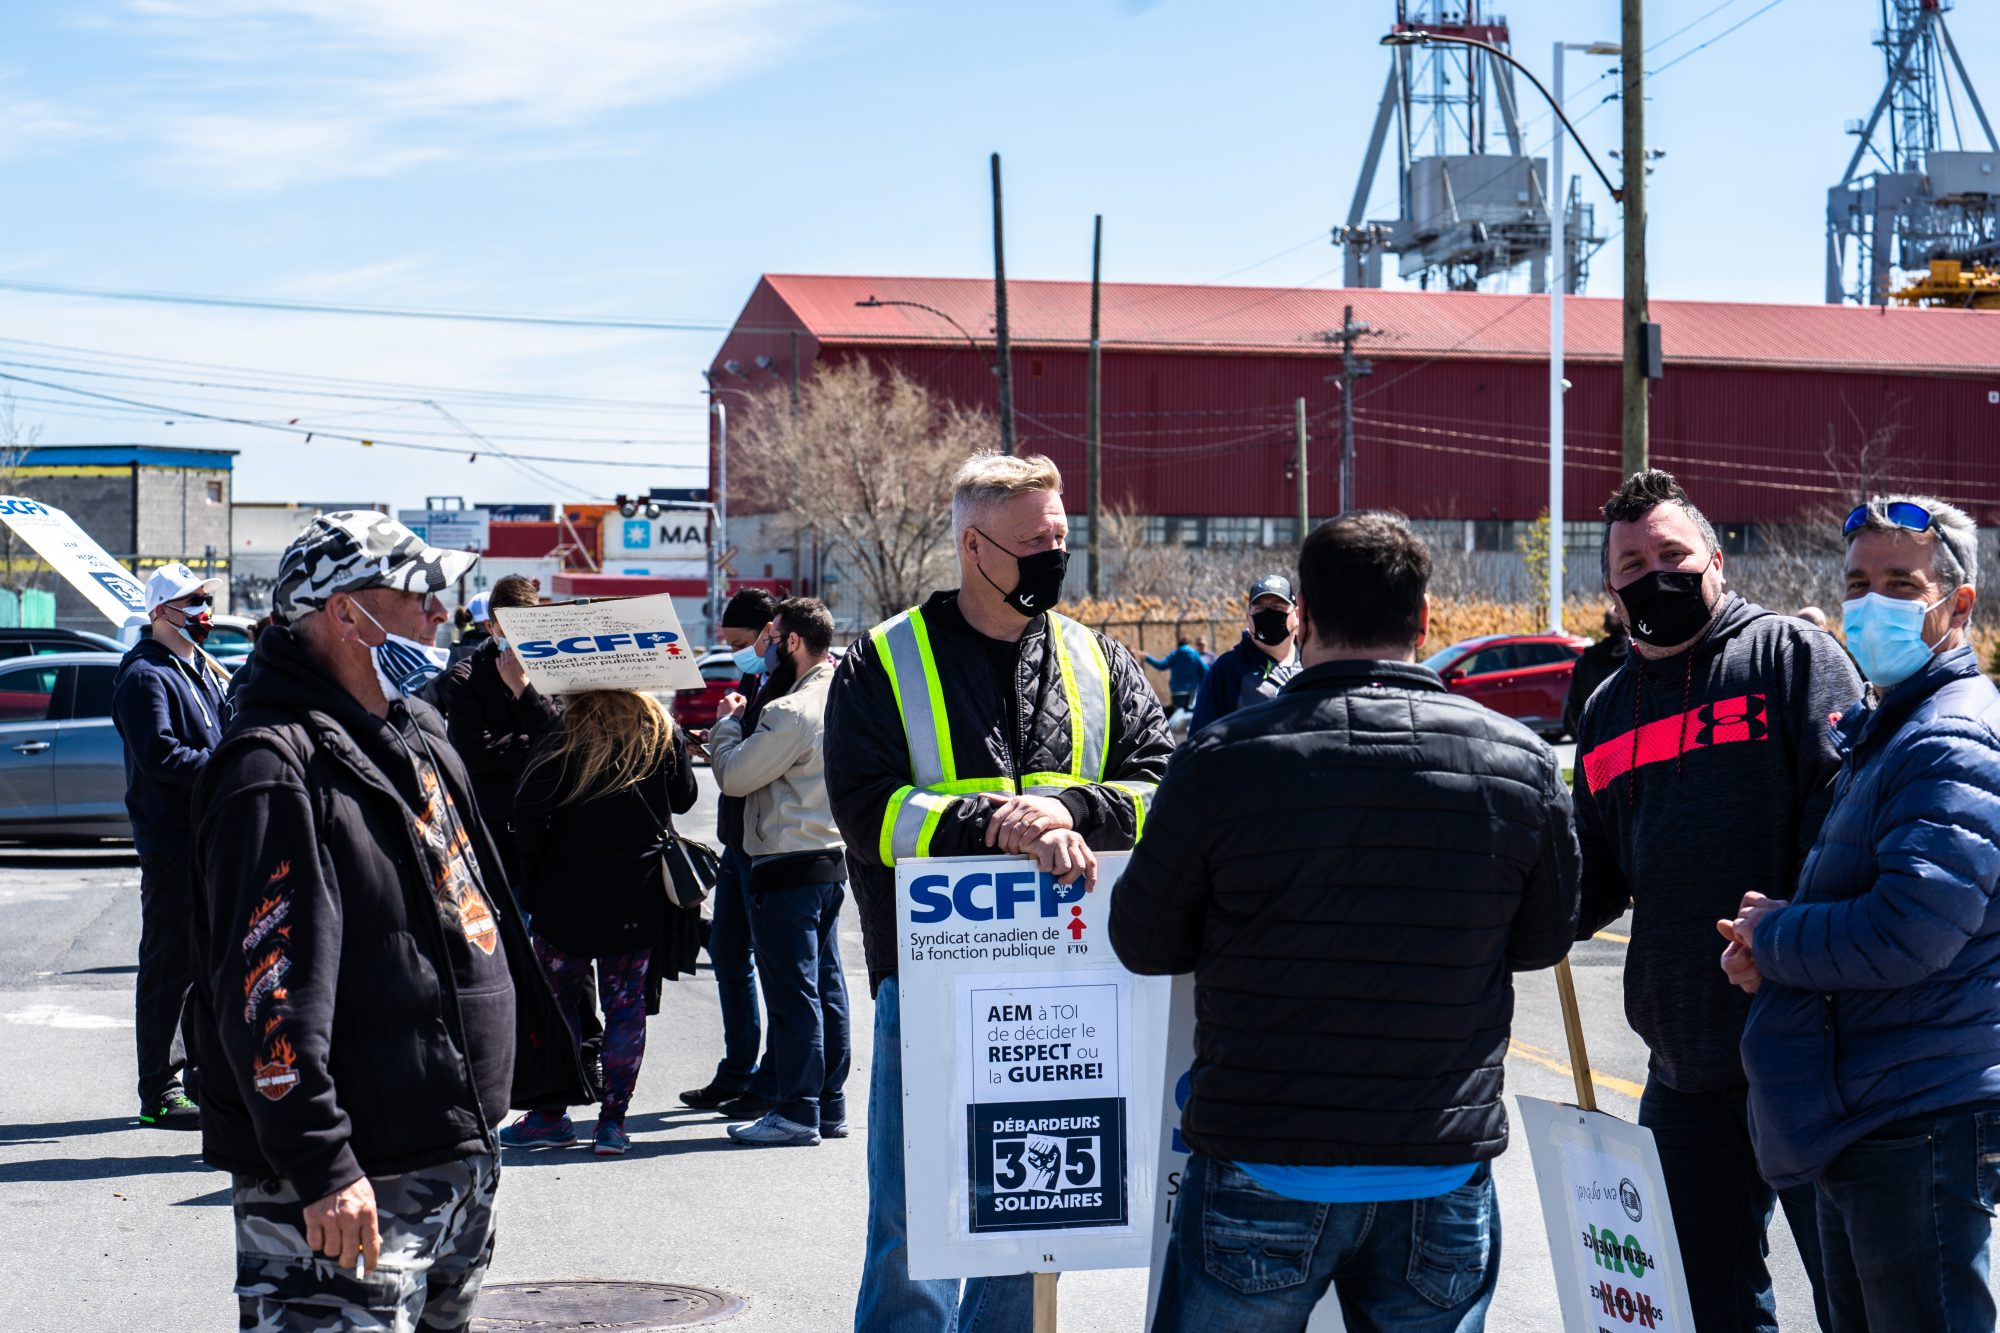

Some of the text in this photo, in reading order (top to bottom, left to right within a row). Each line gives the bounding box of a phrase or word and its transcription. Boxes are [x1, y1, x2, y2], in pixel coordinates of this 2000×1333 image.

[660, 526, 709, 544] MA
[517, 631, 679, 659] SCFP
[525, 650, 659, 667] Syndicat canadien de
[528, 656, 657, 671] la fonction publique
[909, 871, 1087, 924] SCFP
[910, 927, 1060, 948] Syndicat canadien de
[911, 943, 1056, 961] la fonction publique
[1067, 944, 1089, 954] FTQ
[987, 1004, 1078, 1022] AEM à TOI
[987, 1022, 1096, 1042] de décider le
[988, 1043, 1099, 1063] RESPECT ou
[989, 1062, 1104, 1084] la GUERRE!
[993, 1116, 1100, 1133] DÉBARDEURS
[994, 1192, 1103, 1212] SOLIDAIRES
[1603, 1187, 1617, 1200] en
[1581, 1231, 1655, 1270] PERMANENCE
[1588, 1223, 1645, 1279] OUI
[1600, 1280, 1656, 1330] NON
